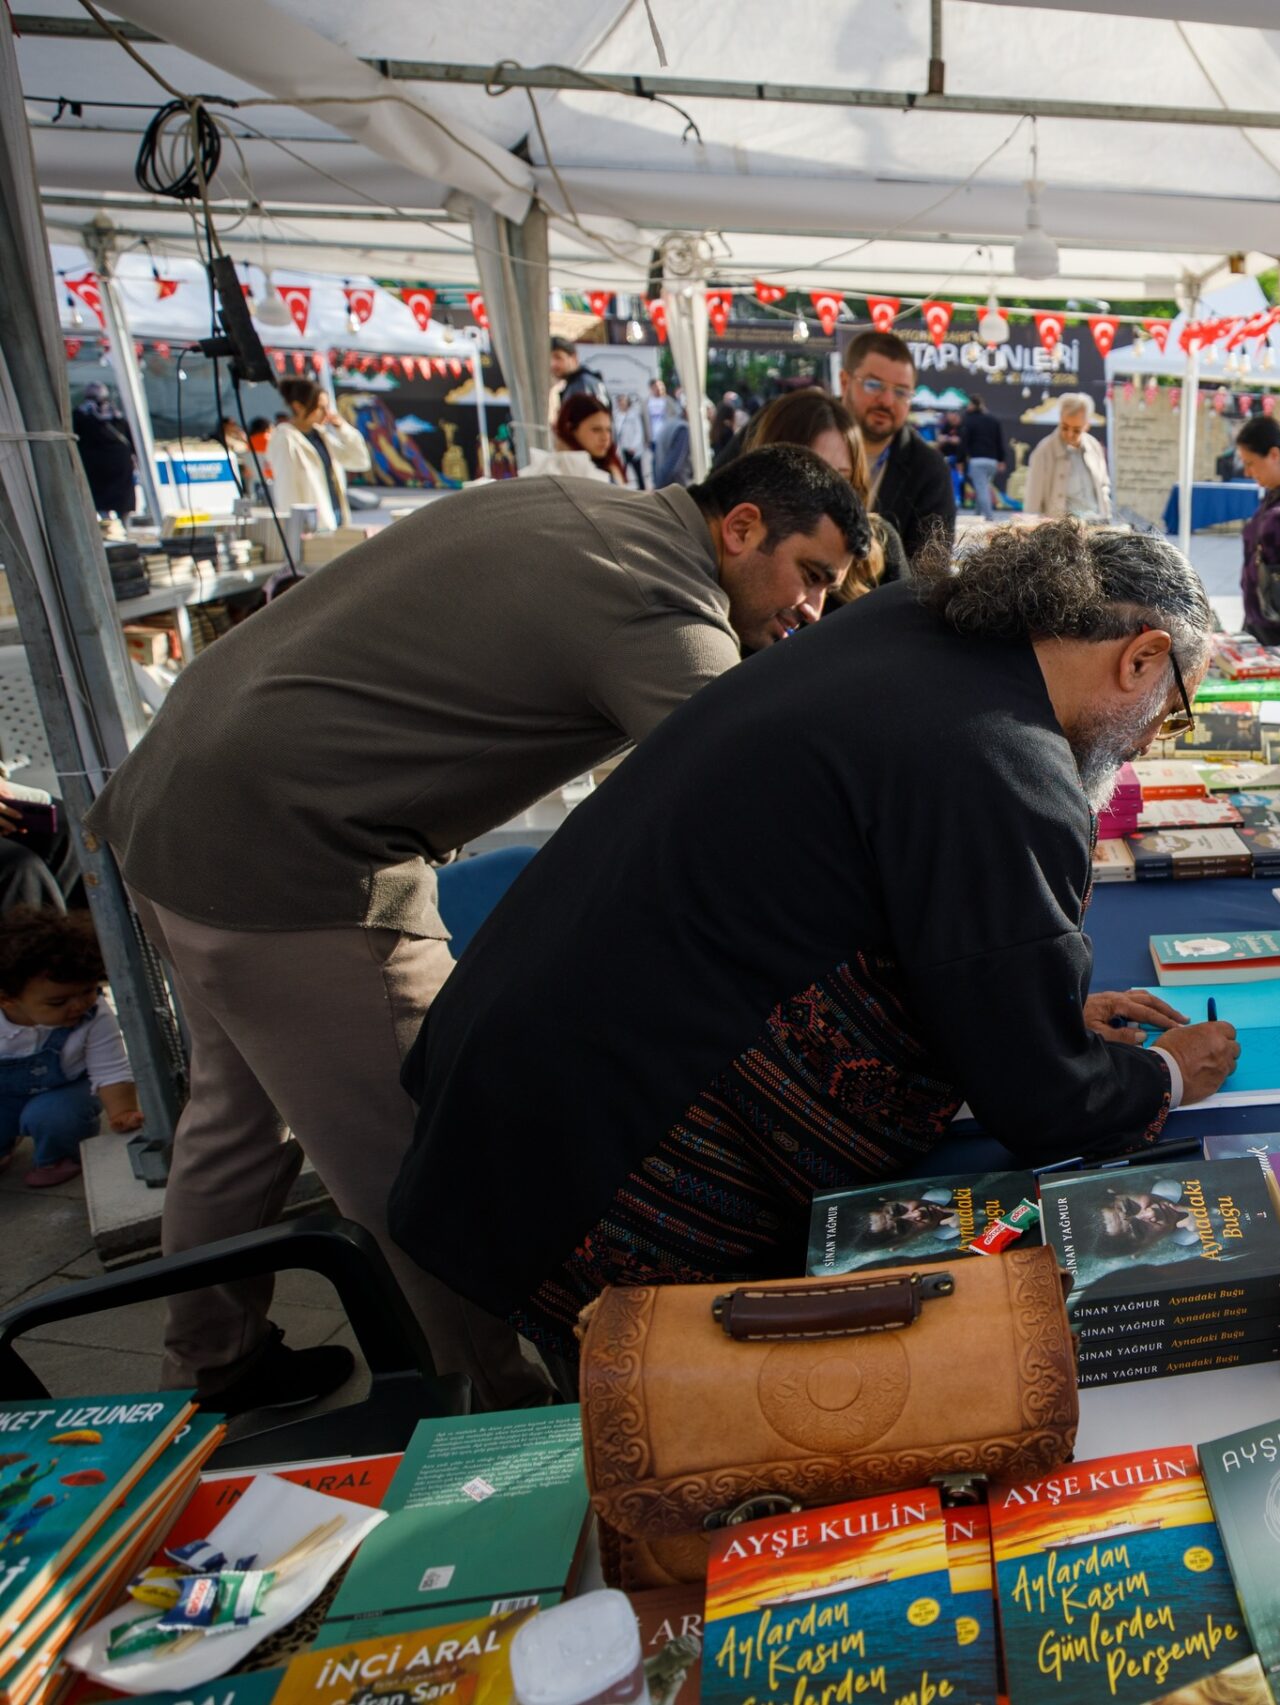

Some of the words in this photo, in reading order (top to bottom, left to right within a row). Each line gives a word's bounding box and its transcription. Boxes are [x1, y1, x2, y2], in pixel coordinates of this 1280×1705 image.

[909, 342, 958, 371] TAP
[826, 1205, 838, 1240] YAĞMUR
[1058, 1197, 1074, 1244] YAĞMUR
[1181, 1179, 1222, 1262] Aynadaki
[1217, 1195, 1243, 1239] Buğu
[825, 1241, 837, 1267] SİNAN
[1064, 1245, 1078, 1275] SİNAN
[1074, 1306, 1108, 1318] SİNAN
[1113, 1299, 1160, 1313] YAĞMUR
[1169, 1291, 1217, 1306] Aynadaki
[1220, 1288, 1245, 1299] Buğu
[1081, 1325, 1115, 1338] SİNAN
[1119, 1318, 1165, 1332] YAĞMUR
[1173, 1311, 1221, 1324] Aynadaki
[1224, 1306, 1248, 1318] Buğu
[1079, 1349, 1113, 1362] SİNAN
[1117, 1341, 1163, 1356] YAĞMUR
[1171, 1334, 1219, 1348] Aynadaki
[1221, 1330, 1245, 1341] Buğu
[1113, 1364, 1158, 1379] YAĞMUR
[1166, 1358, 1213, 1371] Aynadaki
[1216, 1353, 1240, 1364] Buğu
[55, 1403, 164, 1428] UZUNER
[1003, 1476, 1081, 1509] AYŞE
[1089, 1458, 1188, 1492] KULİN
[722, 1525, 809, 1562] AYŞE
[820, 1503, 927, 1543] KULİN
[1012, 1545, 1130, 1614] Aylardan
[1061, 1571, 1150, 1625] Kasım
[315, 1646, 401, 1690] İNCİ
[405, 1629, 500, 1672] ARAL
[716, 1601, 849, 1679] Aylardan
[769, 1629, 865, 1691] Kasım
[1038, 1606, 1175, 1682] Günlerden
[1106, 1614, 1239, 1696] Perşembe
[412, 1681, 456, 1702] Sarı
